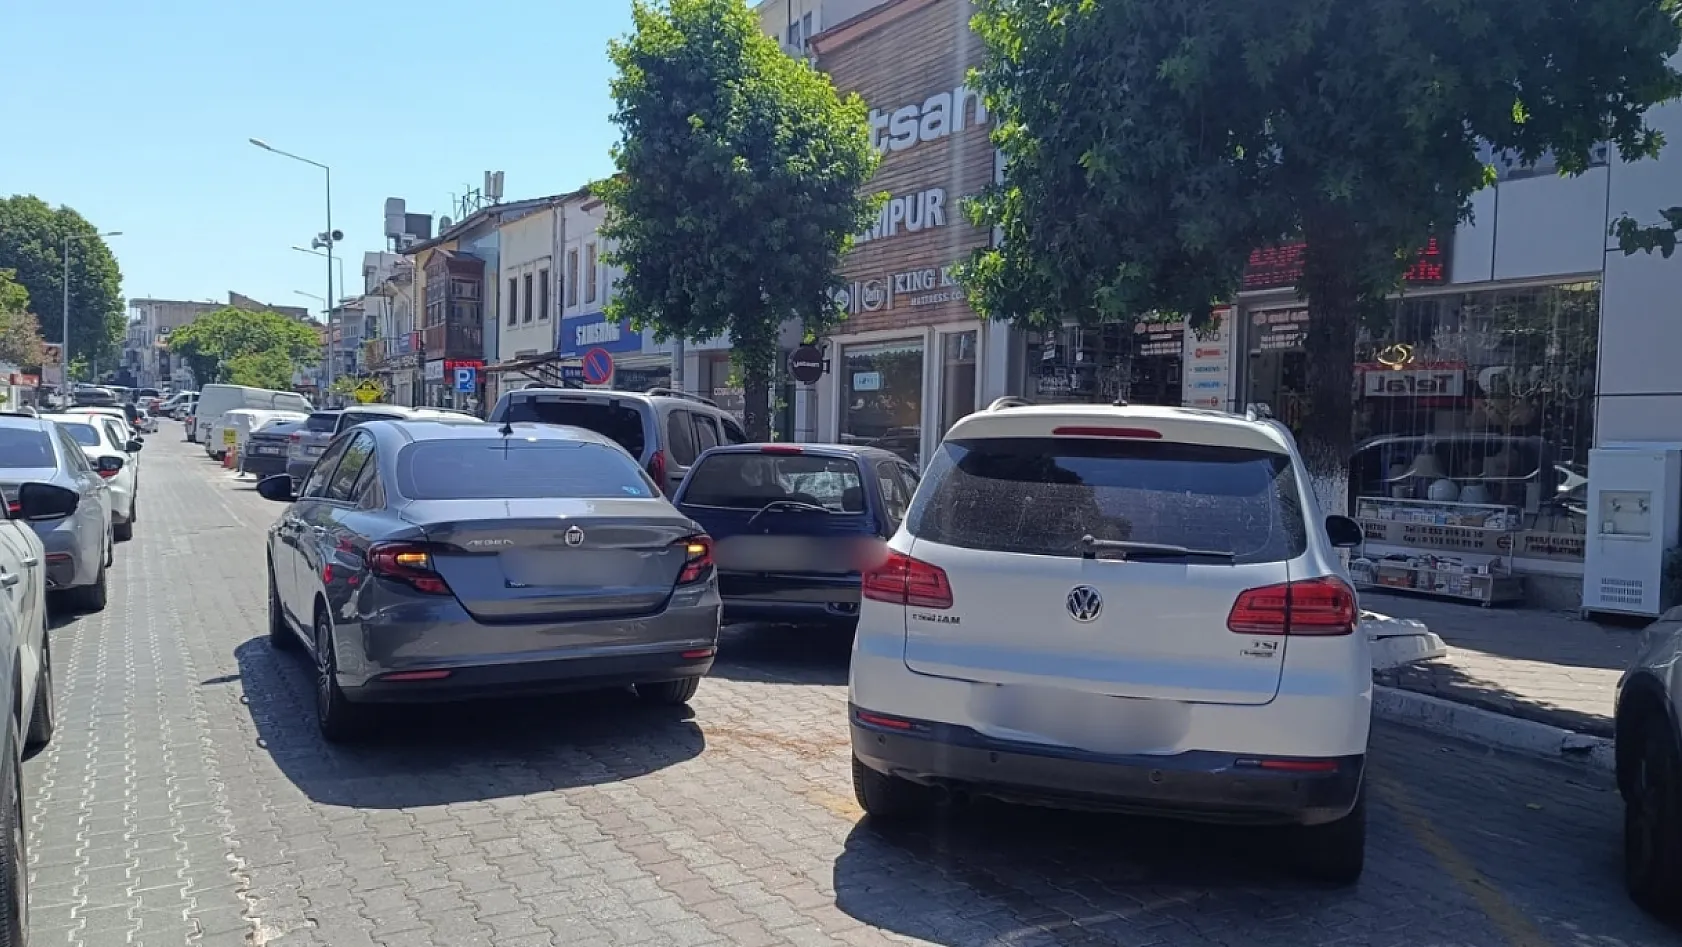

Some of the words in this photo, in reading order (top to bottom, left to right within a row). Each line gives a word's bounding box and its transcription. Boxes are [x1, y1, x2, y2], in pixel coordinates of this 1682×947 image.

[869, 86, 988, 152] tsan
[895, 268, 936, 293] KING
[455, 369, 470, 389] P
